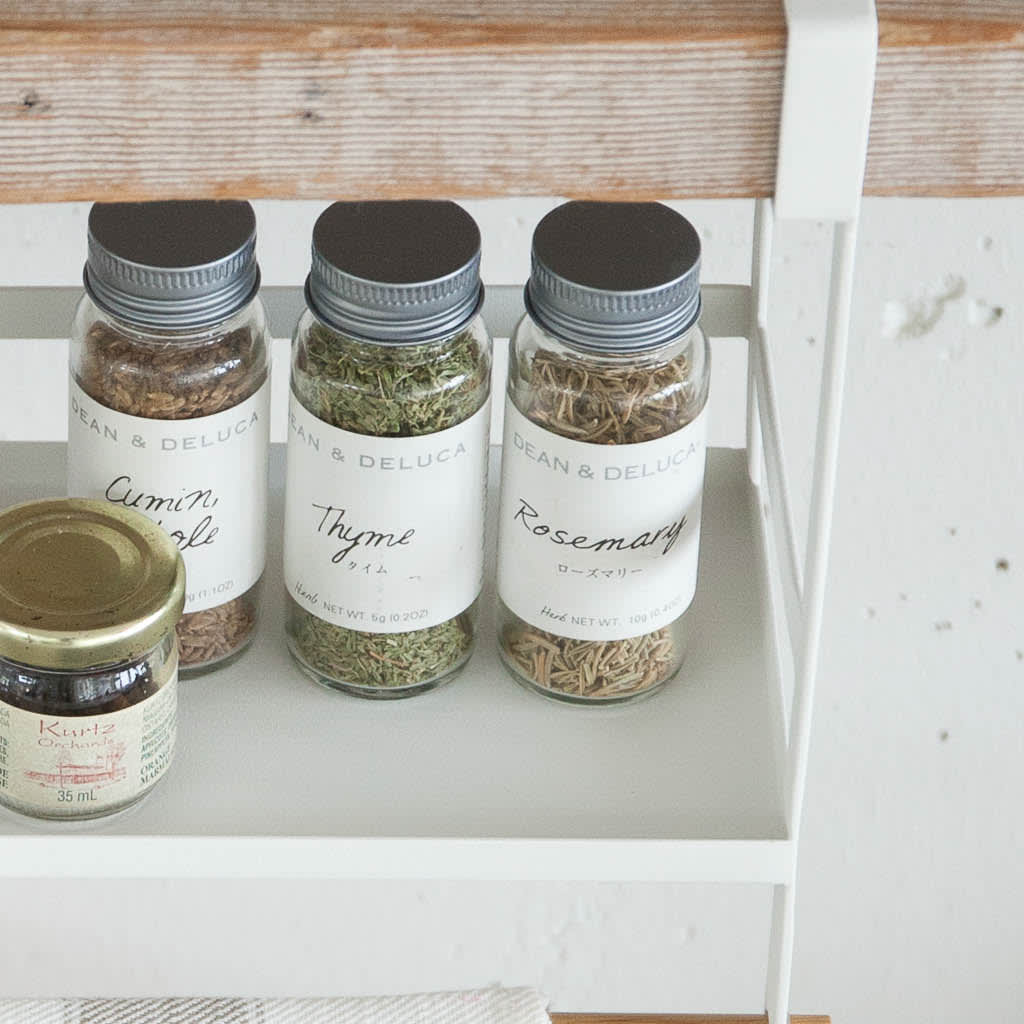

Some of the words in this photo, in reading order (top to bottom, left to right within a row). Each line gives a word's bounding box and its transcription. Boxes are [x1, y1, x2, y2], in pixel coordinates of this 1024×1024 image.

[72, 396, 118, 442] DEAN
[131, 434, 146, 448] &
[161, 411, 258, 451] DELUCA
[289, 412, 320, 451] EAN
[331, 447, 345, 462] &
[359, 442, 467, 470] DELUCA
[513, 432, 569, 474] DEAN
[578, 464, 594, 479] &
[604, 441, 696, 481] DELUCA
[311, 502, 415, 564] Thyme
[513, 498, 687, 556] Rosemary
[557, 563, 643, 579] ローズマリー
[322, 600, 344, 615] NET
[540, 605, 569, 622] Herb
[571, 615, 595, 626] NET
[39, 719, 115, 738] Kurtz
[57, 789, 73, 802] 35
[77, 788, 98, 801] mL
